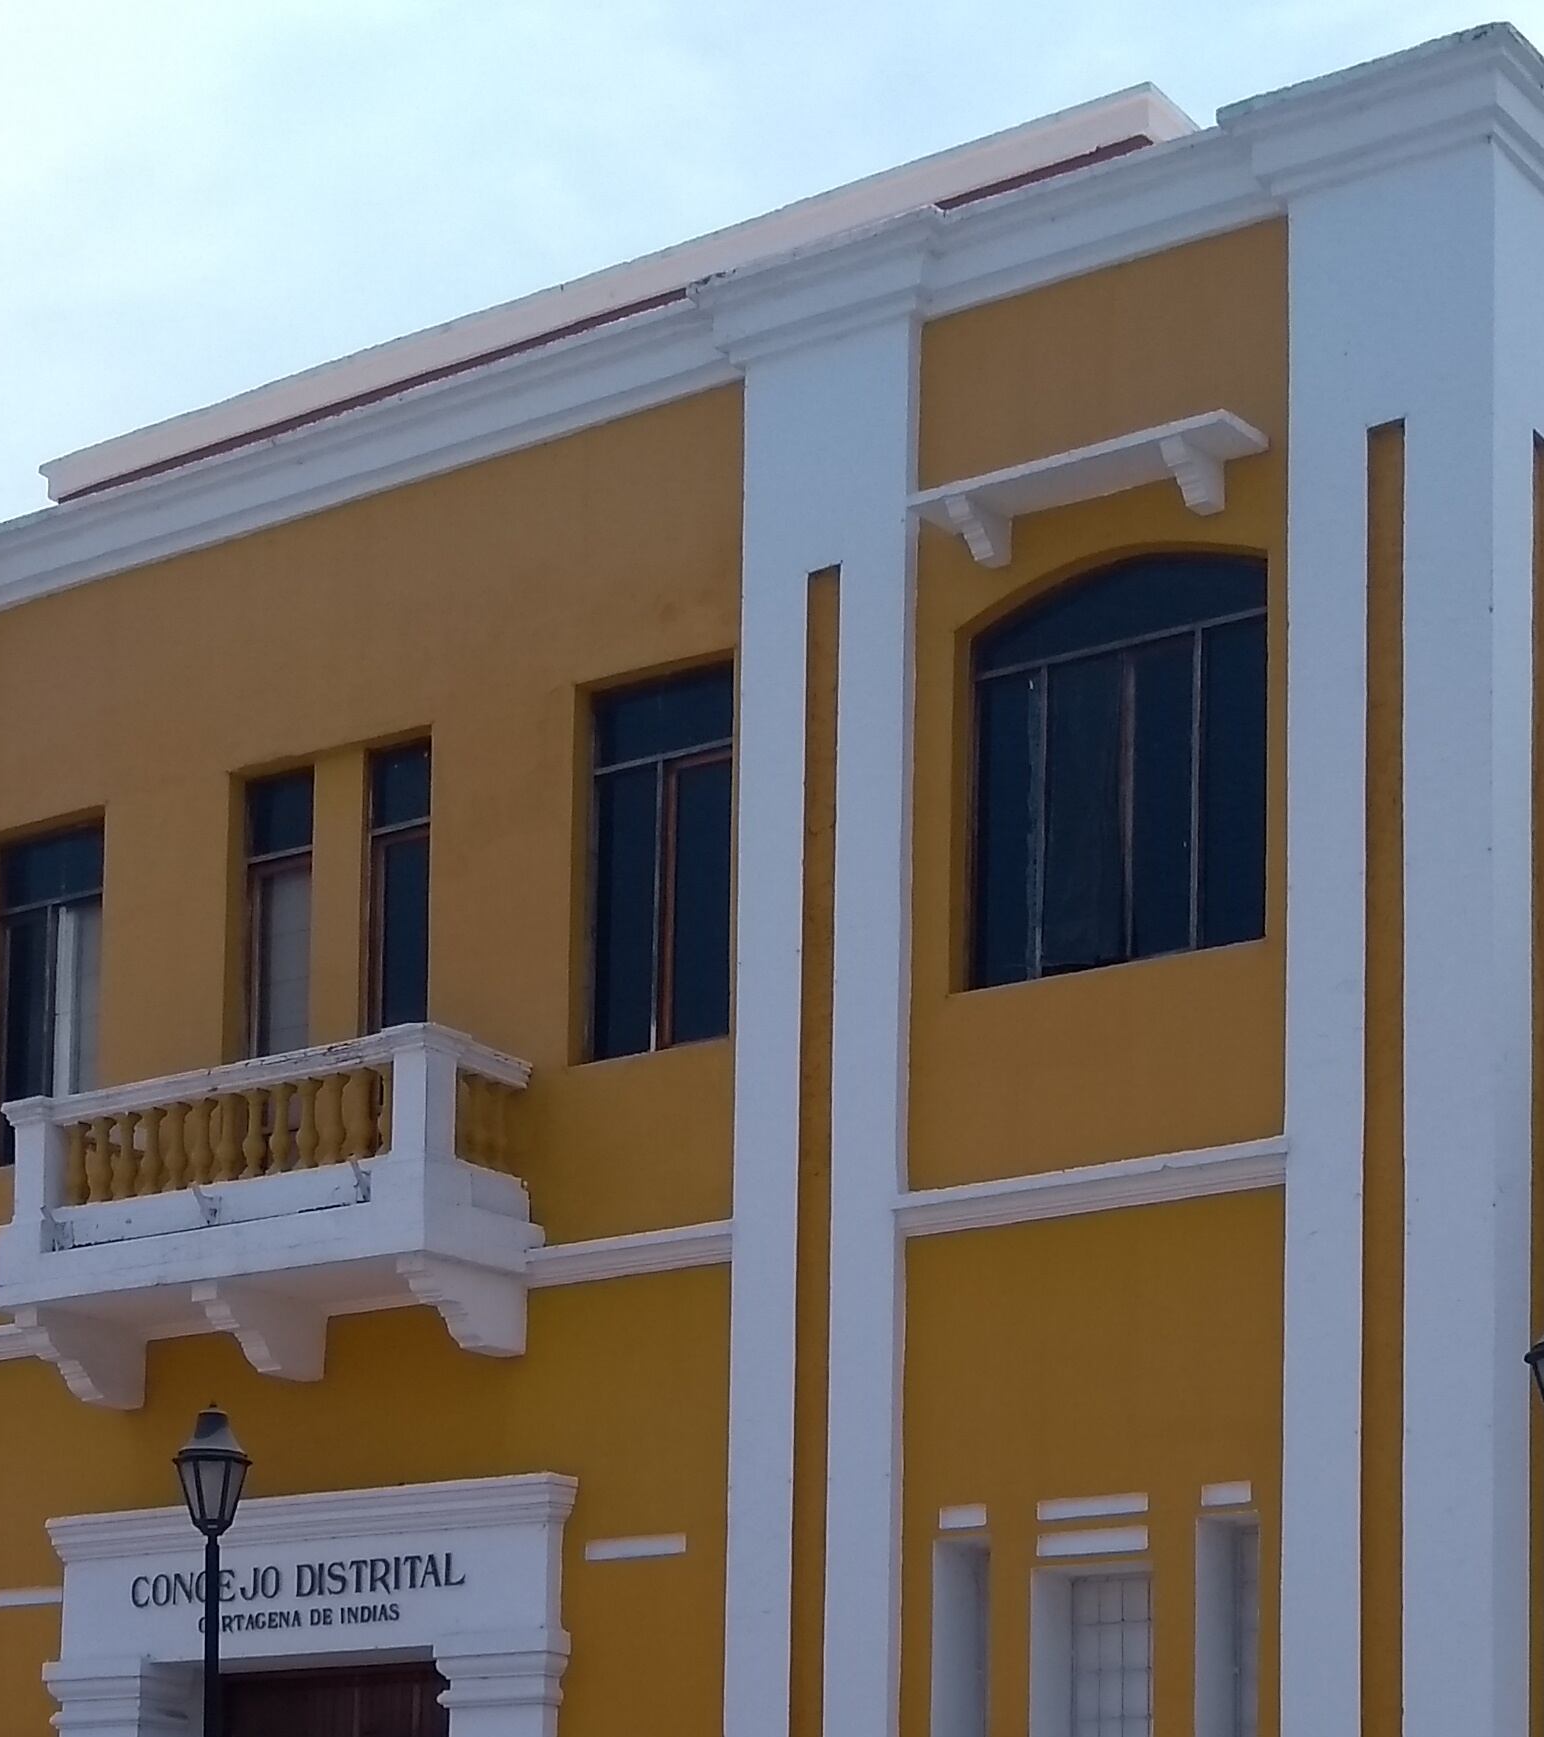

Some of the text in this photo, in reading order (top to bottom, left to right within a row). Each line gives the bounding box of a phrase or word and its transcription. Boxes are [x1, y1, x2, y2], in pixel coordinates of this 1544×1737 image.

[296, 1552, 466, 1595] DISTRITAL
[198, 1603, 400, 1634] CRTAGENA DE INDIAS
